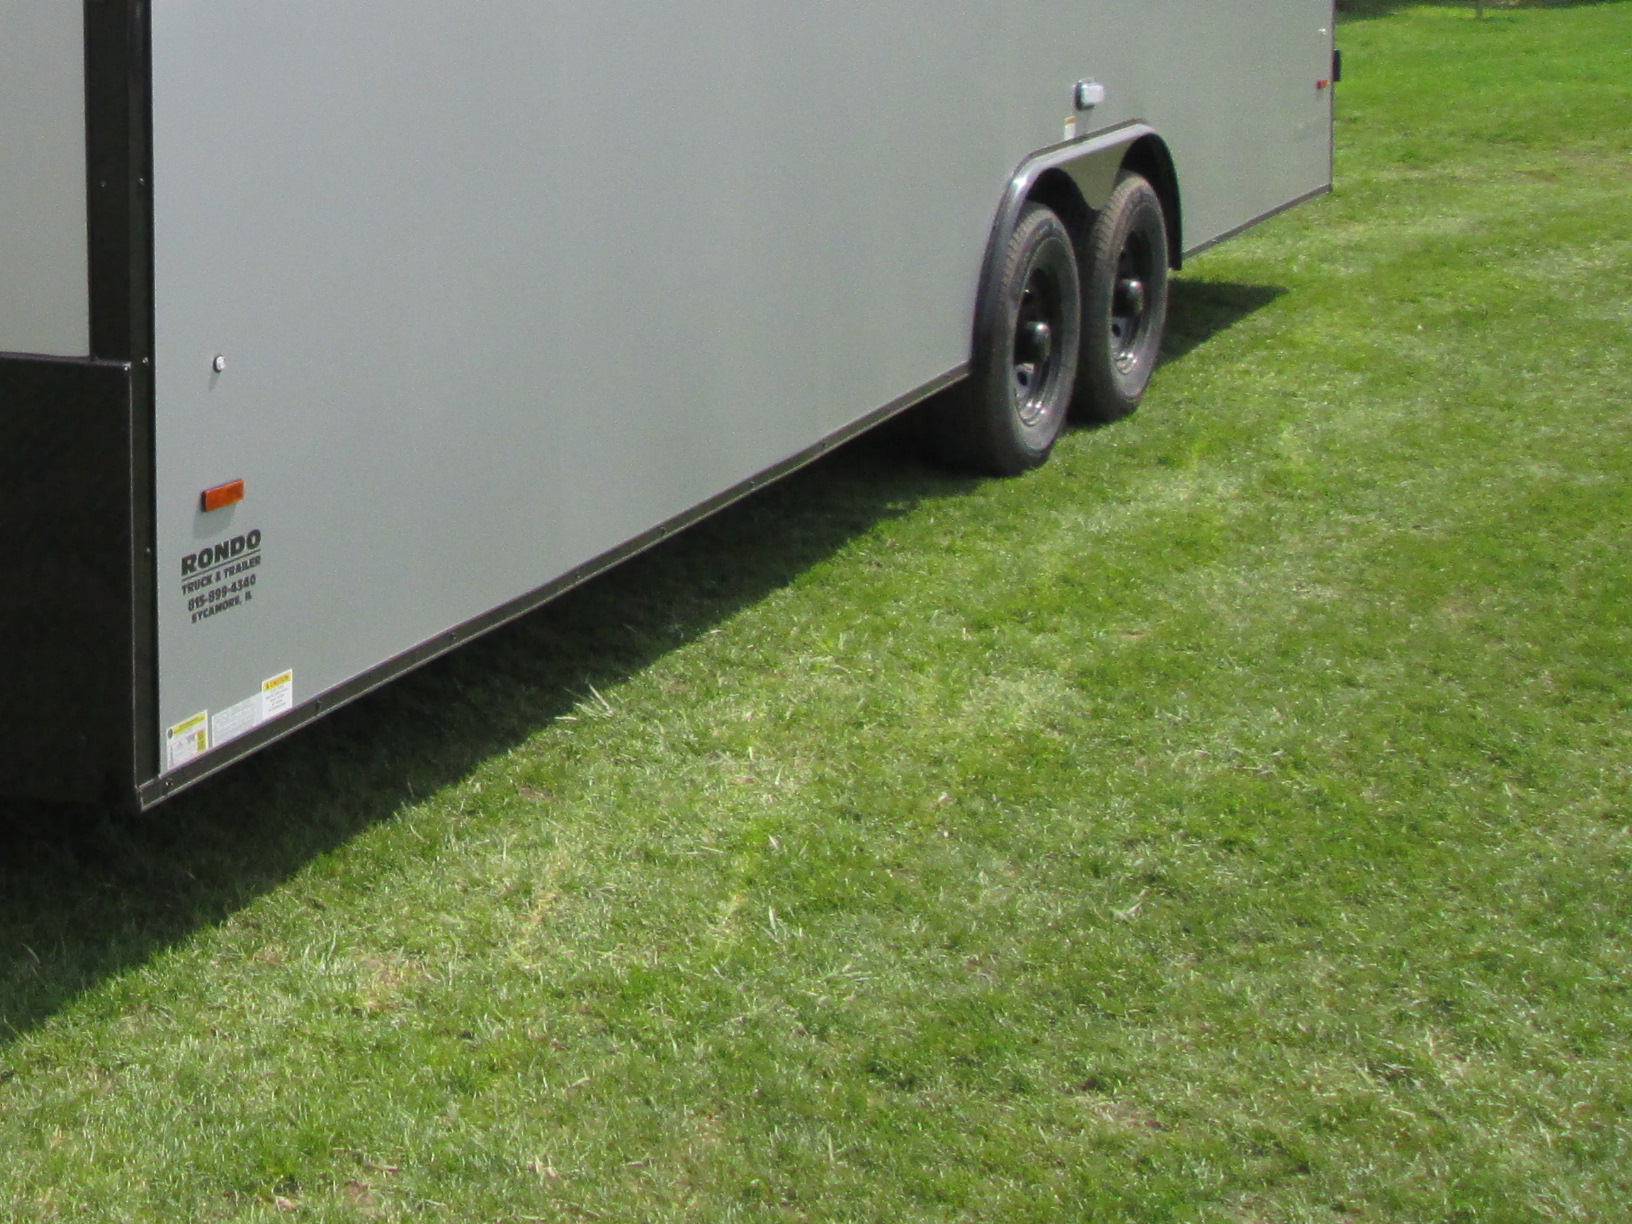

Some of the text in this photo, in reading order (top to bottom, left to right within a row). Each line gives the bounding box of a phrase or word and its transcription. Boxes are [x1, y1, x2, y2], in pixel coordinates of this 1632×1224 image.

[181, 529, 261, 576] RONDO
[182, 574, 213, 596] TRUCK
[223, 555, 262, 579] TRAILER
